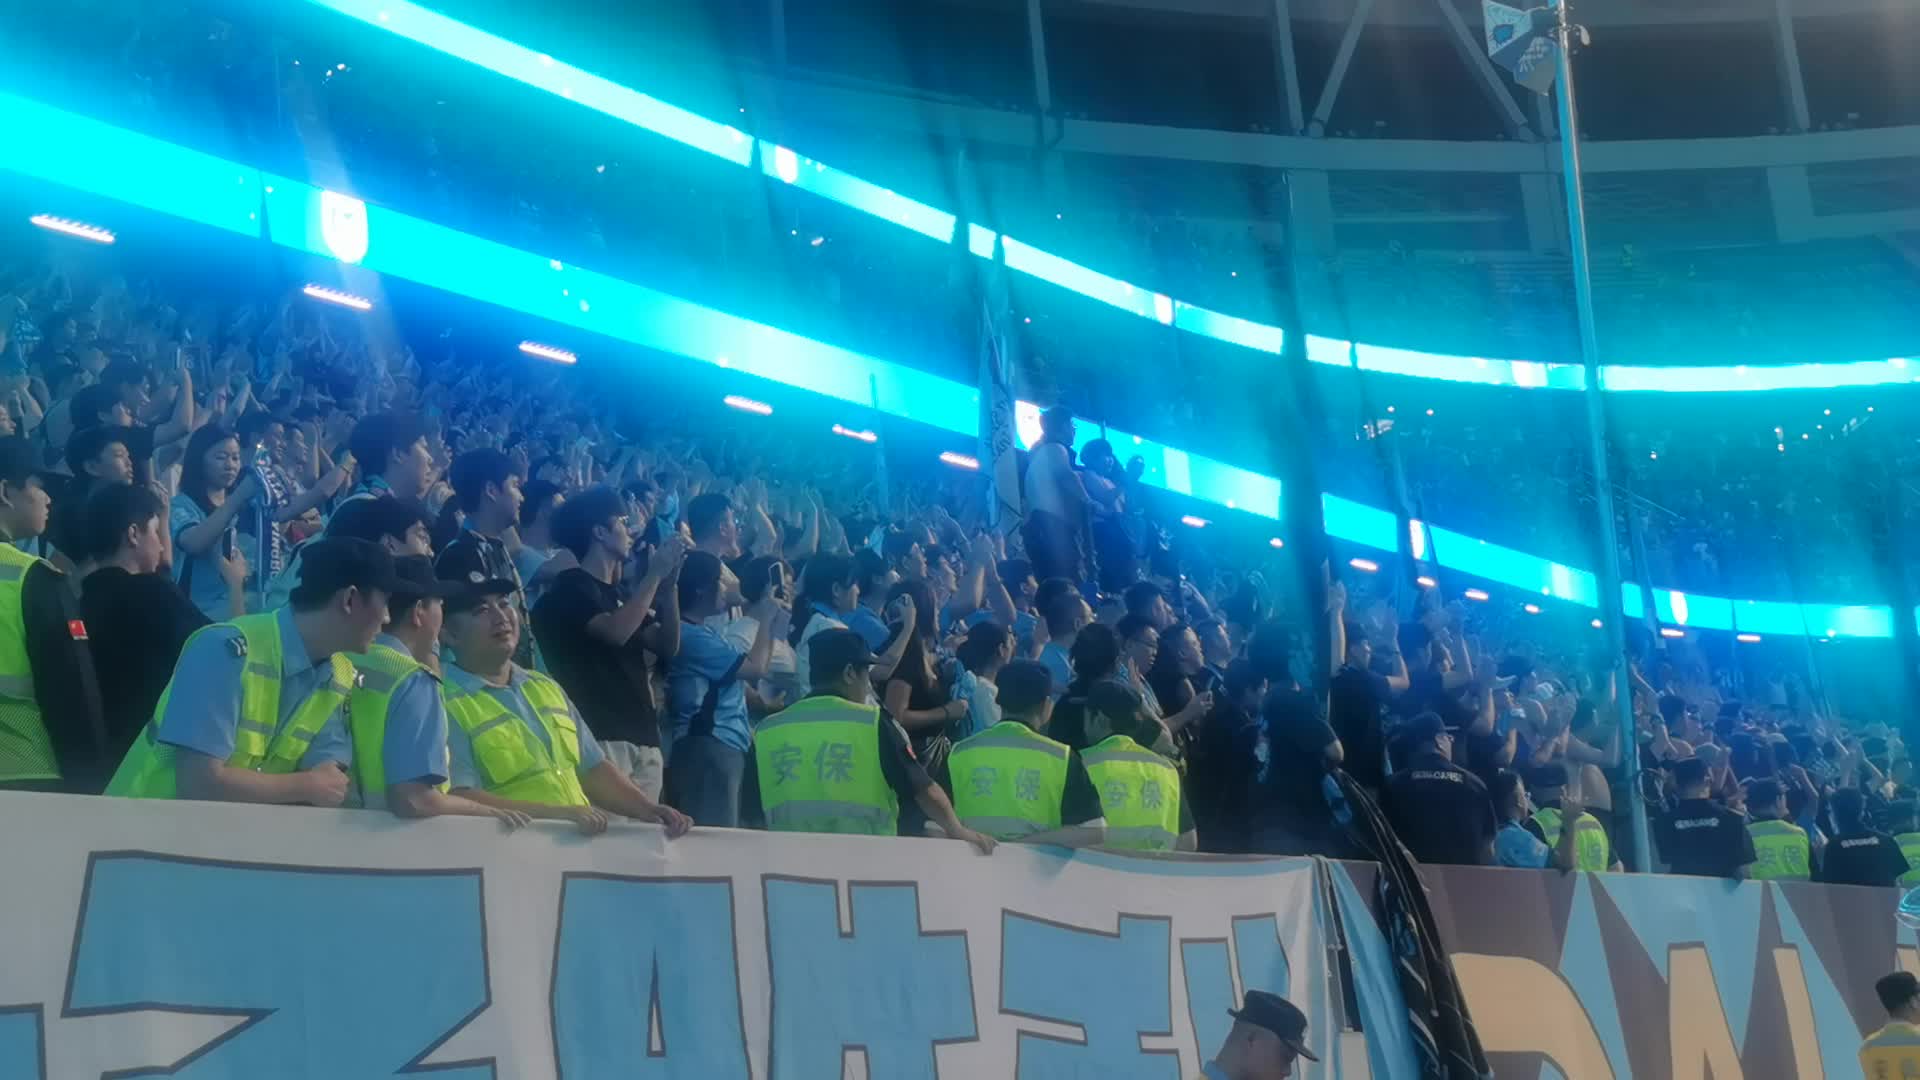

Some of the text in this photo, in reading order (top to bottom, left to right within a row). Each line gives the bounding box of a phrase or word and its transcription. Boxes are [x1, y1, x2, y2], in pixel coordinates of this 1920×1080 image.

[770, 741, 854, 785] 安保
[971, 766, 1040, 801] 安保
[1104, 779, 1162, 810] 安保
